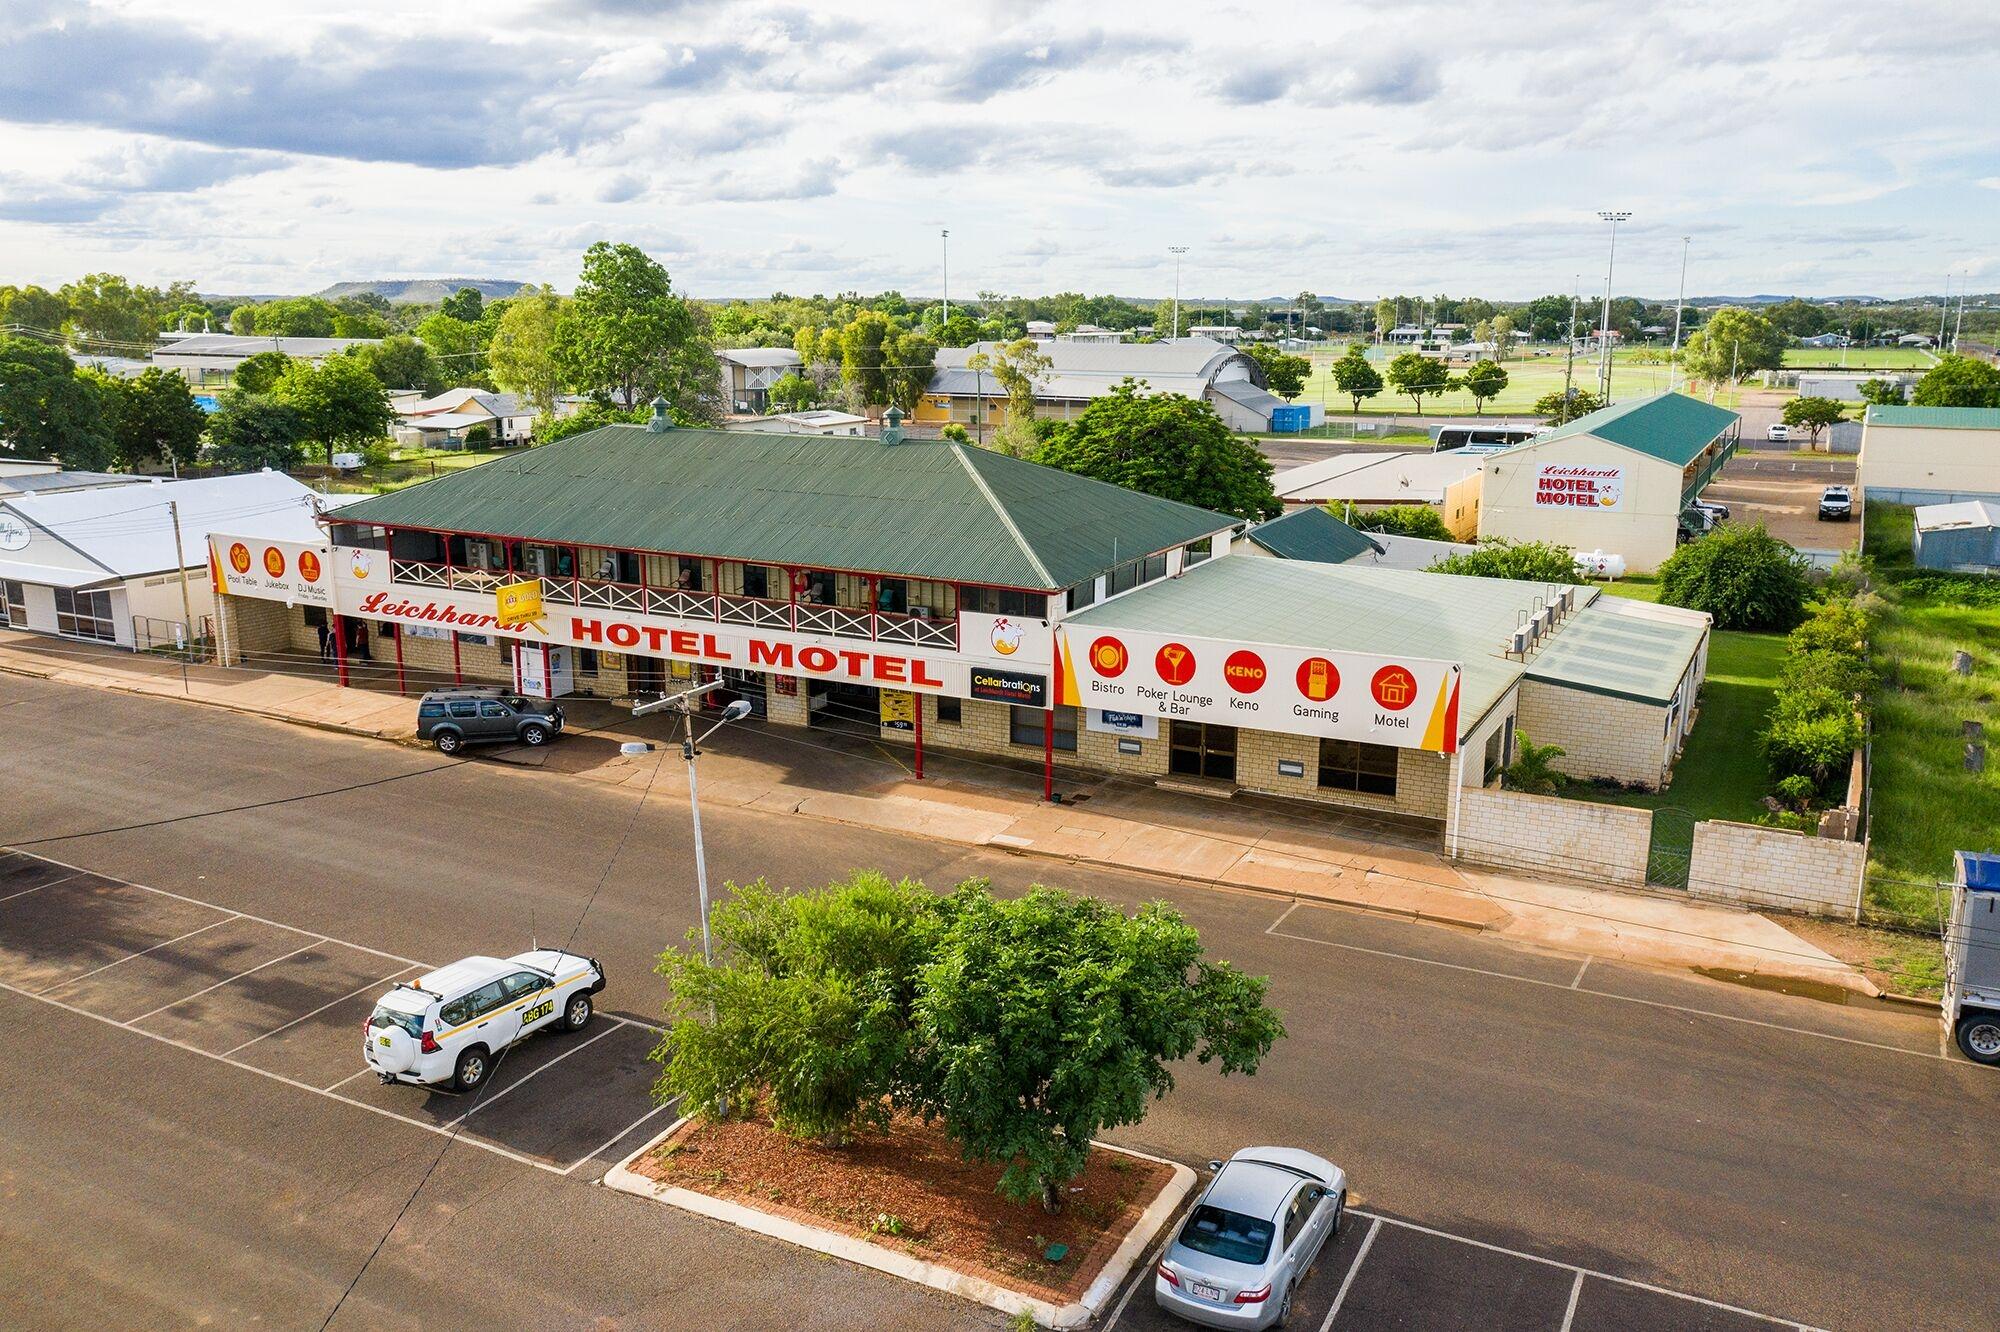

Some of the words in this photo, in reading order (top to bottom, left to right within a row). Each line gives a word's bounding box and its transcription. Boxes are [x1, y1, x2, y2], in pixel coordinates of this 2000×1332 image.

[1541, 465, 1620, 477] Leichhardt
[1538, 478, 1599, 493] HOTEL
[1536, 492, 1599, 507] MOTEL
[227, 574, 241, 584] Pool
[241, 576, 258, 586] Table
[264, 579, 290, 590] Jukebox
[297, 583, 308, 593] DJ
[308, 584, 326, 596] Music
[571, 618, 731, 660] HOTEL
[749, 639, 943, 687] MOTEL
[1227, 665, 1264, 679] KENO
[1091, 680, 1126, 695] Bistro
[1137, 686, 1169, 701] Poker
[1172, 690, 1214, 707] Lounge
[1229, 697, 1260, 711] Keno
[1158, 701, 1168, 713] &
[1170, 703, 1191, 716] Bar
[1293, 704, 1340, 723] Gaming
[1374, 714, 1410, 729] Motel
[523, 1007, 540, 1024] ABG
[541, 1001, 553, 1015] 174
